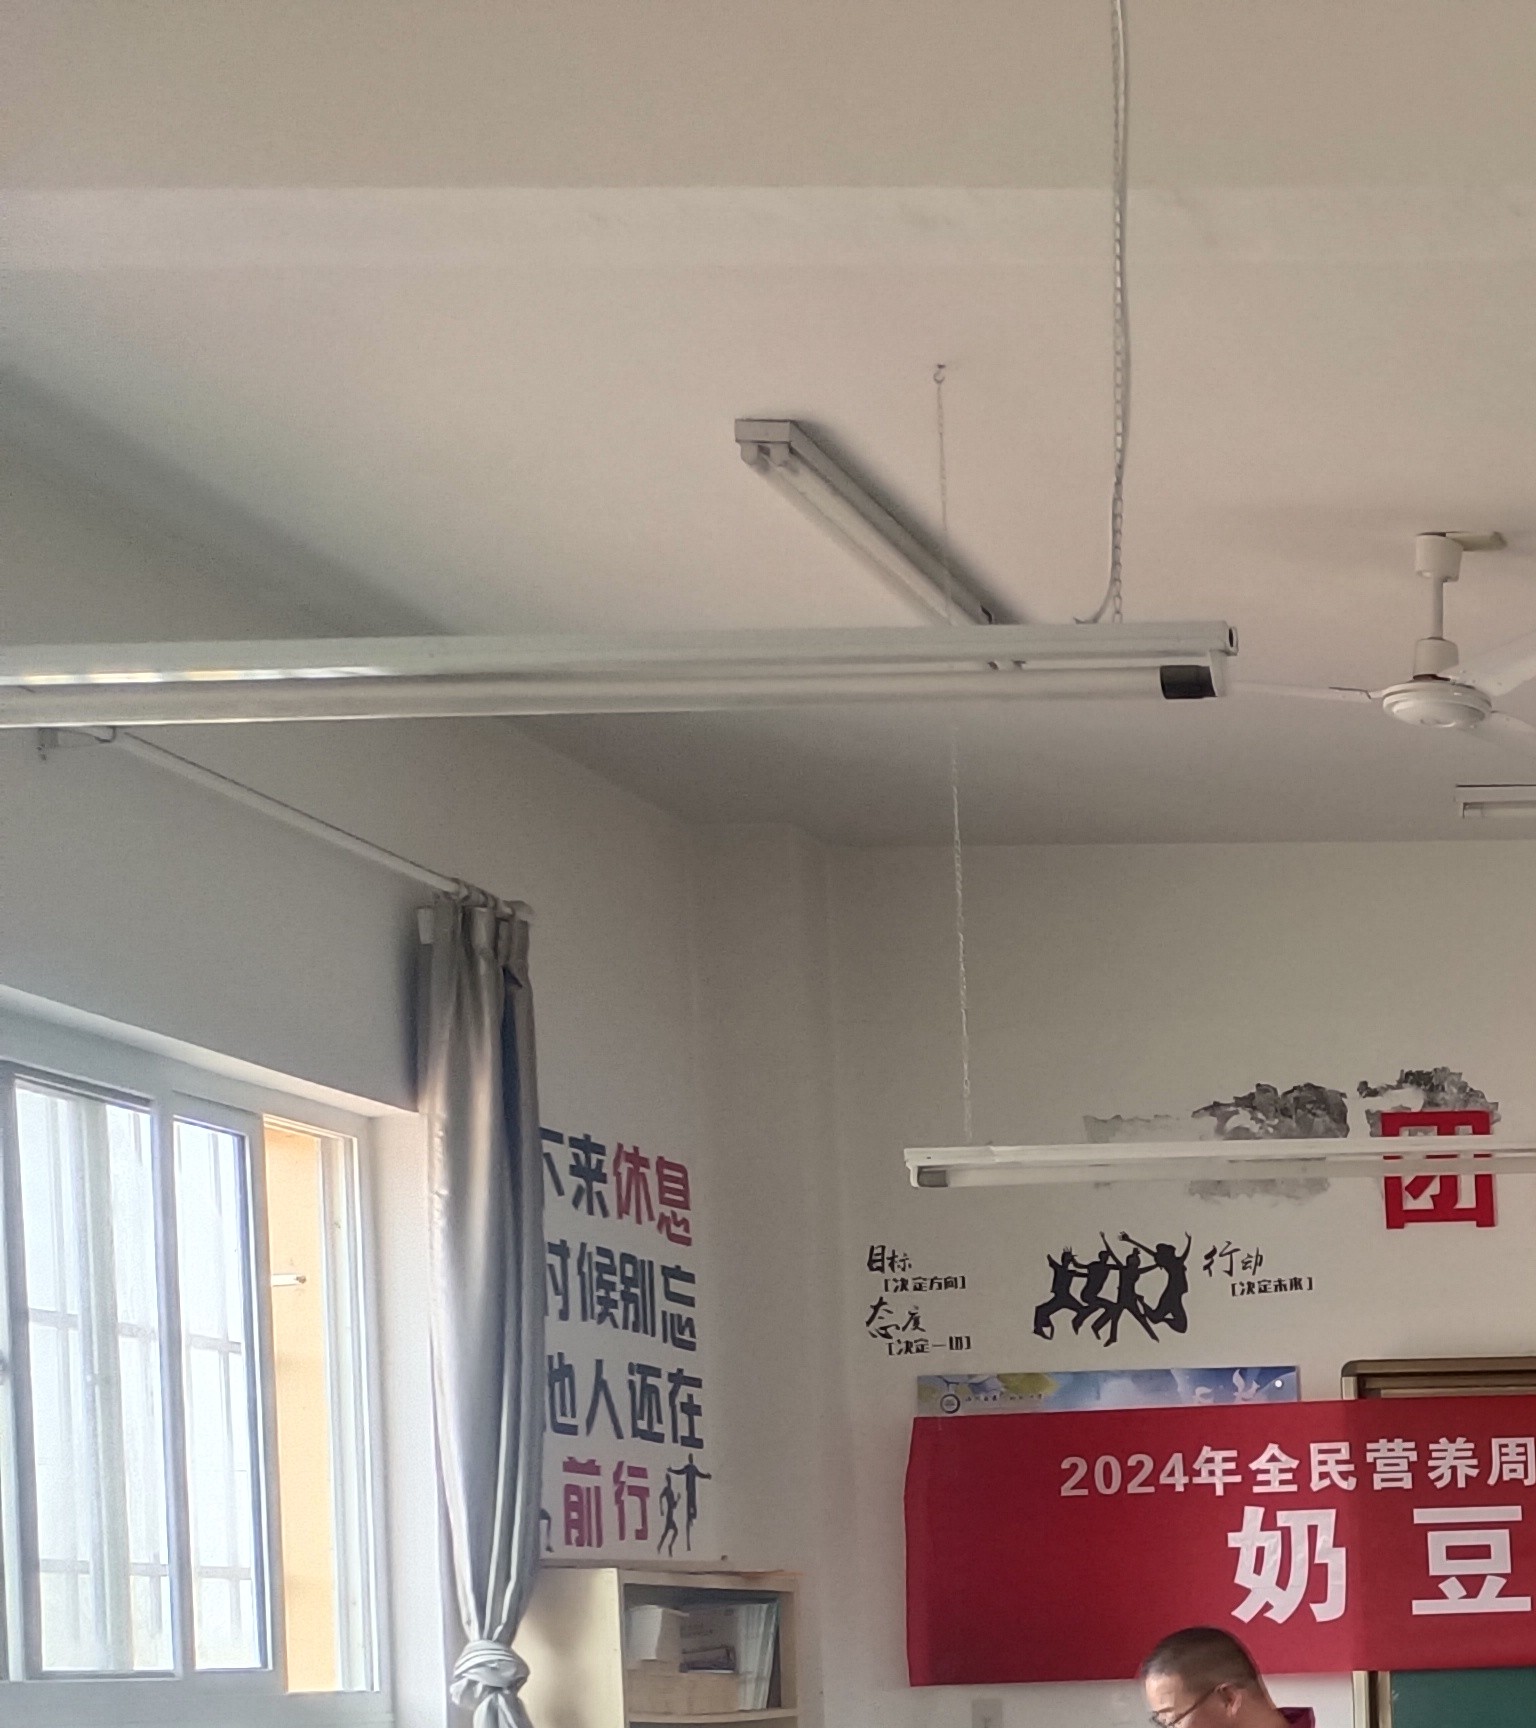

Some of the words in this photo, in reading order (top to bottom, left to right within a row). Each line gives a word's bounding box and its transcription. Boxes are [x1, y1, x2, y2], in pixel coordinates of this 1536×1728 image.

[866, 1245, 913, 1274] 目标
[1202, 1241, 1263, 1278] 行动
[865, 1297, 926, 1340] 态度
[562, 1456, 649, 1548] 前行
